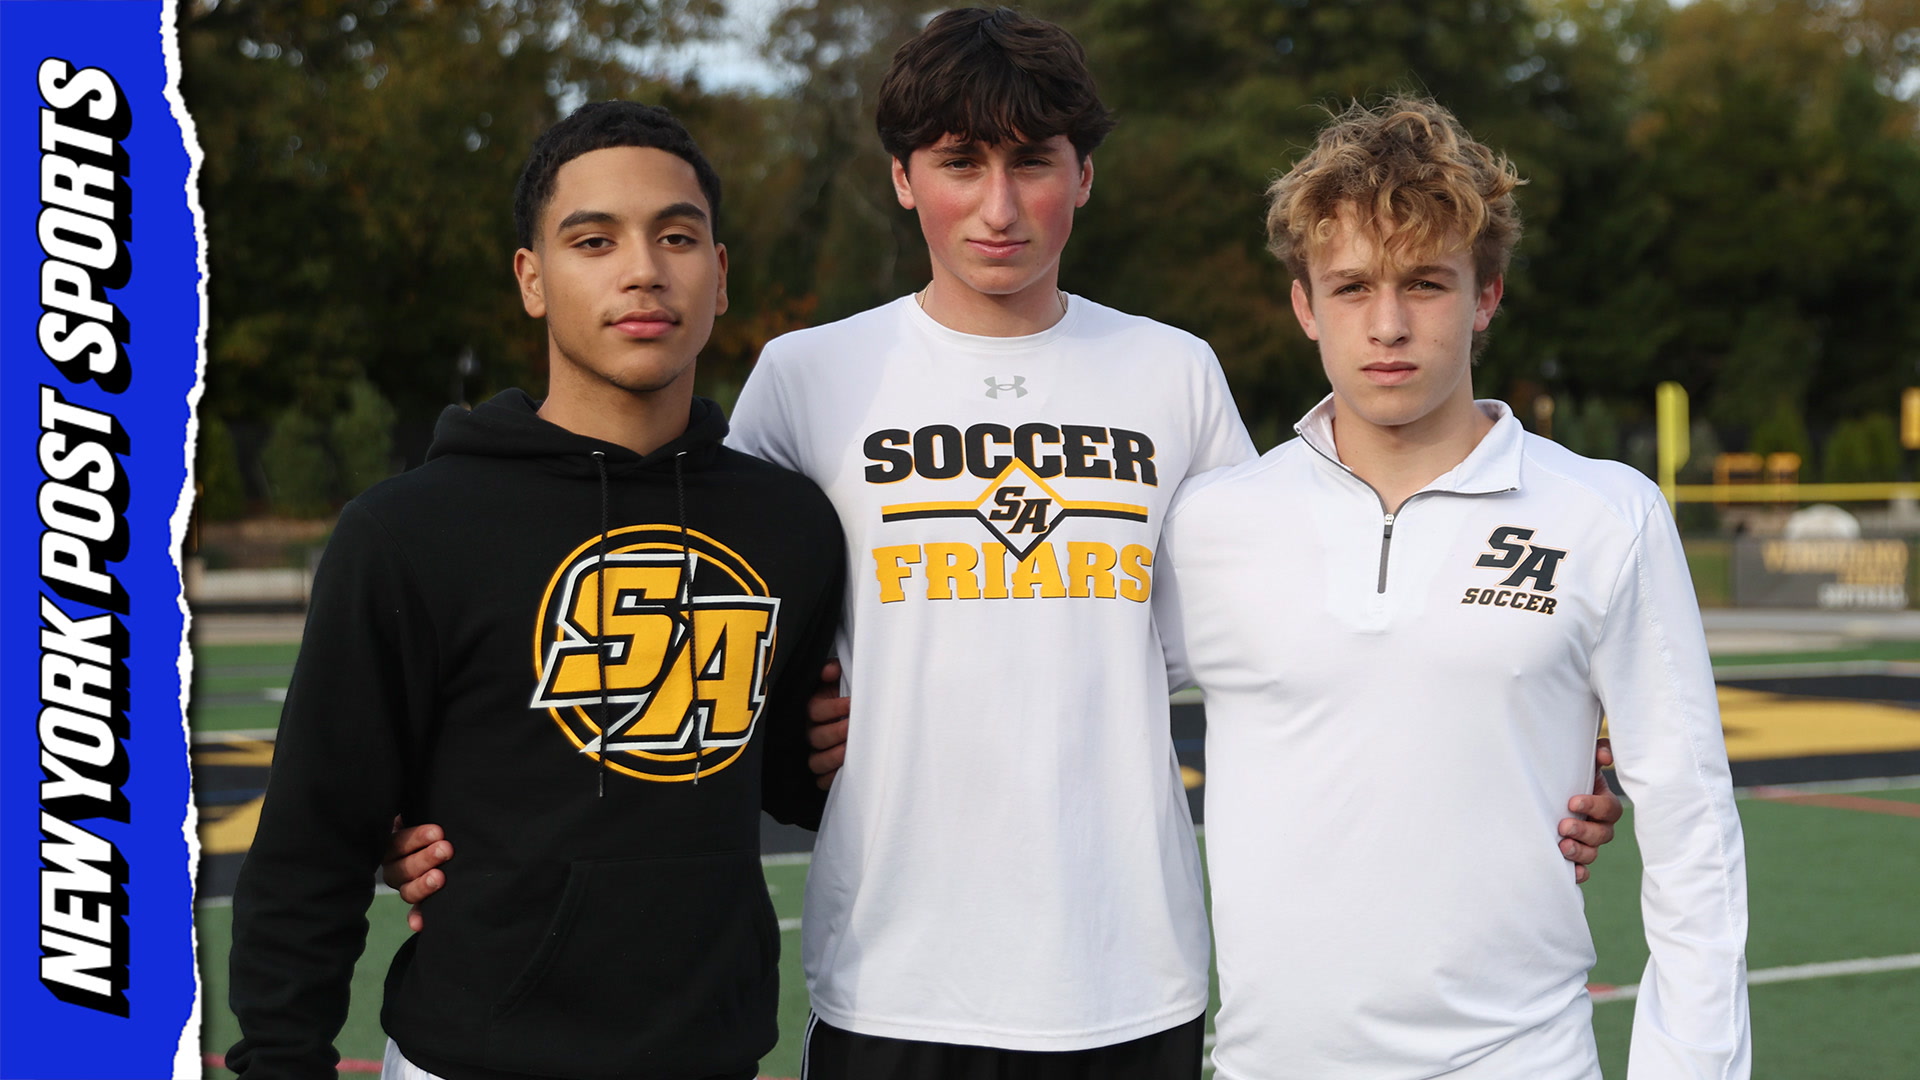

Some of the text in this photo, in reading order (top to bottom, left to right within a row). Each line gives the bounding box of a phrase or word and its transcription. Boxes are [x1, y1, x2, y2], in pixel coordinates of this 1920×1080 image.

[863, 422, 1158, 487] SOCCER
[988, 486, 1053, 534] SA
[871, 541, 1153, 604] FRIARS
[1474, 525, 1569, 593] SA
[1461, 587, 1558, 615] SOCCER
[540, 559, 777, 746] SA
